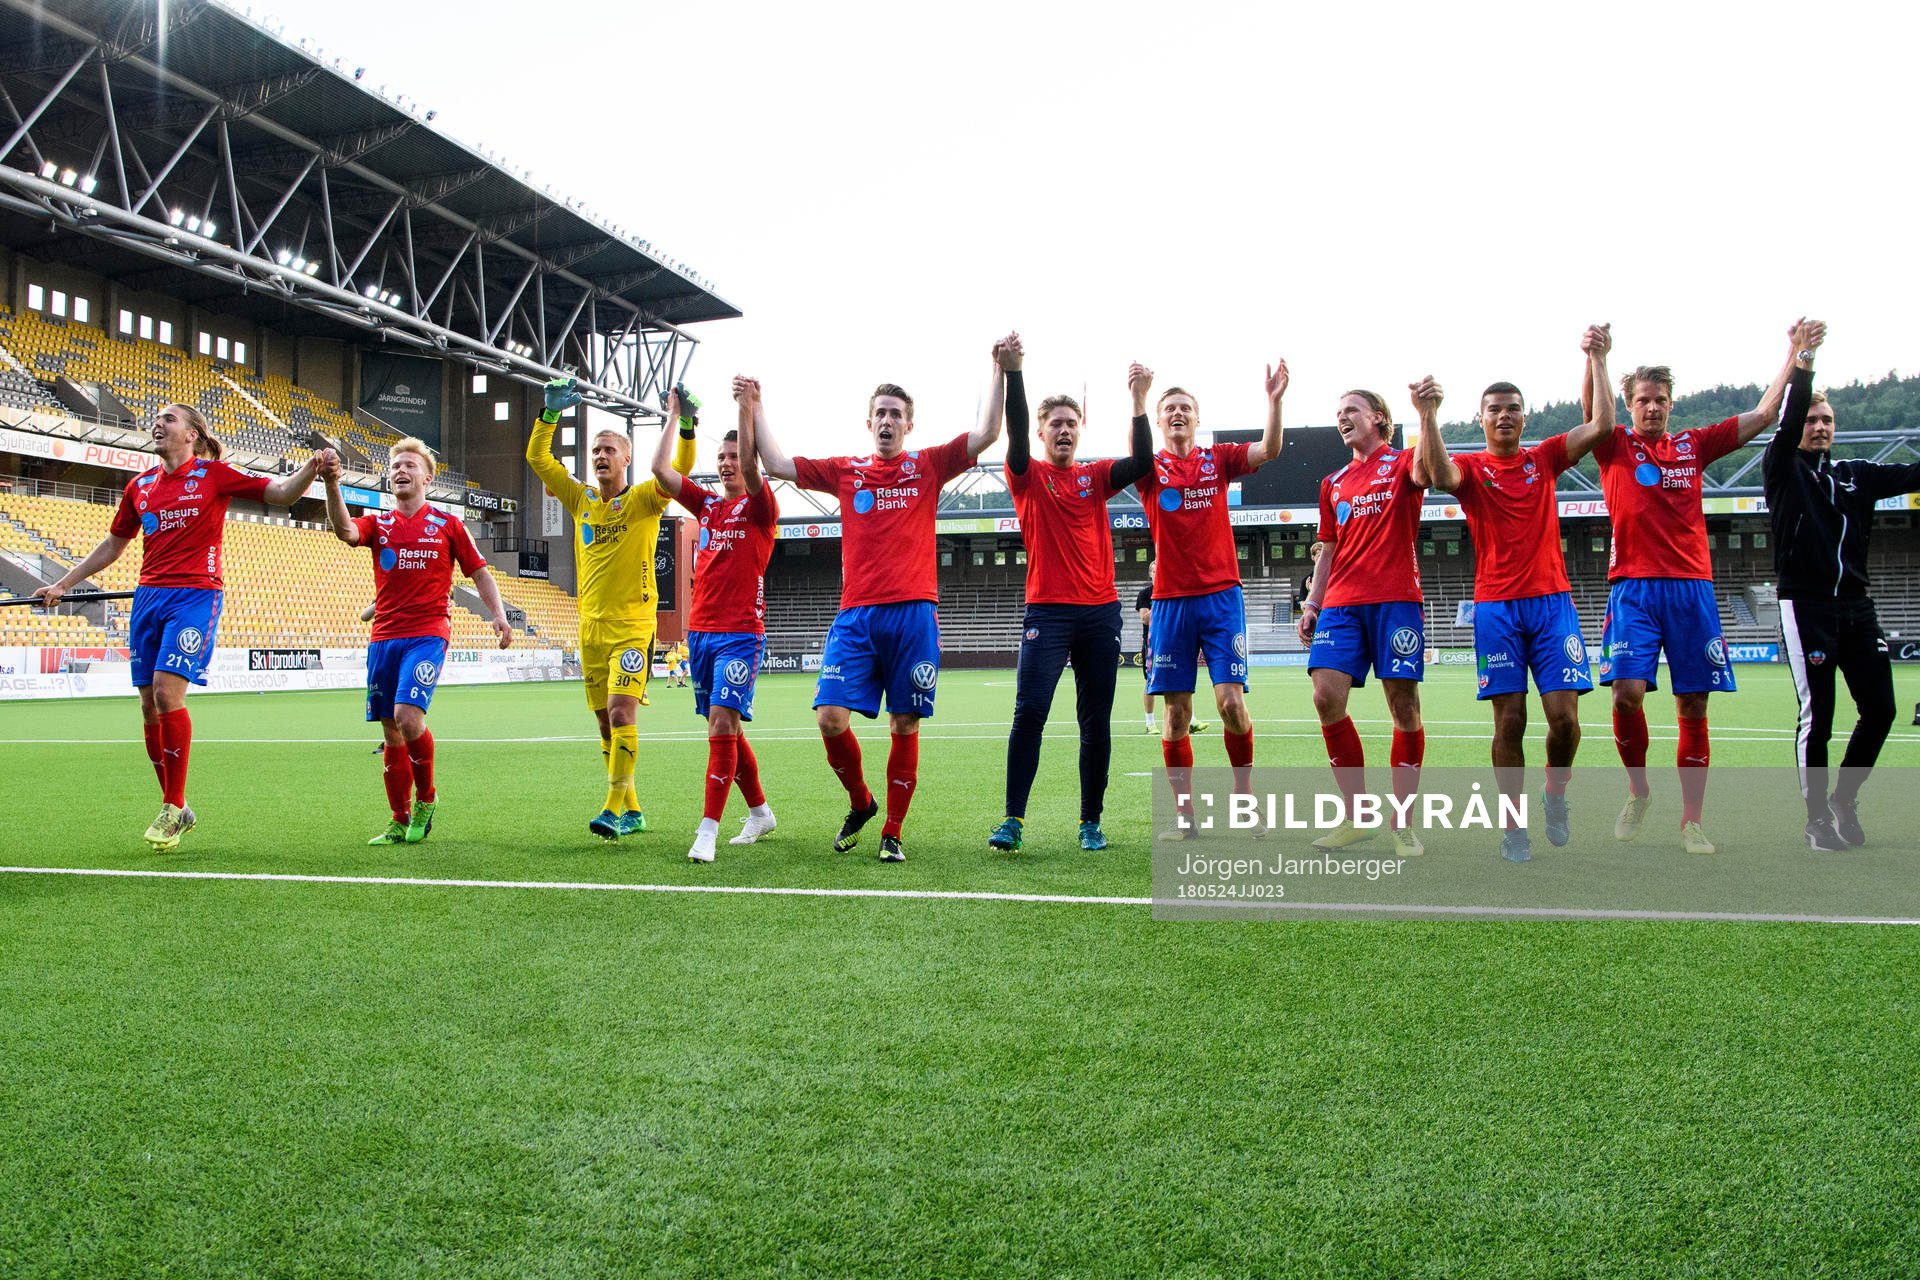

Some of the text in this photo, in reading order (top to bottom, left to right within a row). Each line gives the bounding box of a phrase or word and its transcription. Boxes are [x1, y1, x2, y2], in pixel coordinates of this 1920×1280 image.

[84, 446, 151, 470] PULSEN
[1662, 477, 1692, 489] Bank
[877, 487, 919, 498] Resurs
[1184, 486, 1219, 499] Resurs
[1352, 490, 1393, 507] Resurs
[877, 498, 908, 511] Bank
[1184, 497, 1213, 510] Bank
[159, 507, 199, 519] Resurs
[1230, 511, 1277, 524] Sjuhärad
[1353, 504, 1382, 518] Bank
[160, 518, 187, 531] Bank
[1113, 514, 1144, 528] ellos
[595, 524, 628, 535] Resurs
[711, 529, 746, 541] Resurs
[595, 534, 620, 544] Bank
[709, 540, 733, 551] Bank
[399, 548, 439, 559] Resurs
[398, 559, 426, 570] Bank
[166, 653, 183, 668] 21
[451, 651, 479, 662] PEAB
[1154, 654, 1171, 663] Solid
[1487, 652, 1508, 662] Solid
[822, 665, 841, 673] Solid
[1230, 663, 1244, 676] 99
[1392, 659, 1400, 672] 2
[208, 674, 288, 689] RTNERGROUP
[615, 674, 630, 687] 30
[1562, 668, 1578, 683] 23
[1712, 671, 1721, 685] 3
[410, 687, 419, 699] 6
[720, 687, 729, 700] 9
[911, 692, 923, 706] 11
